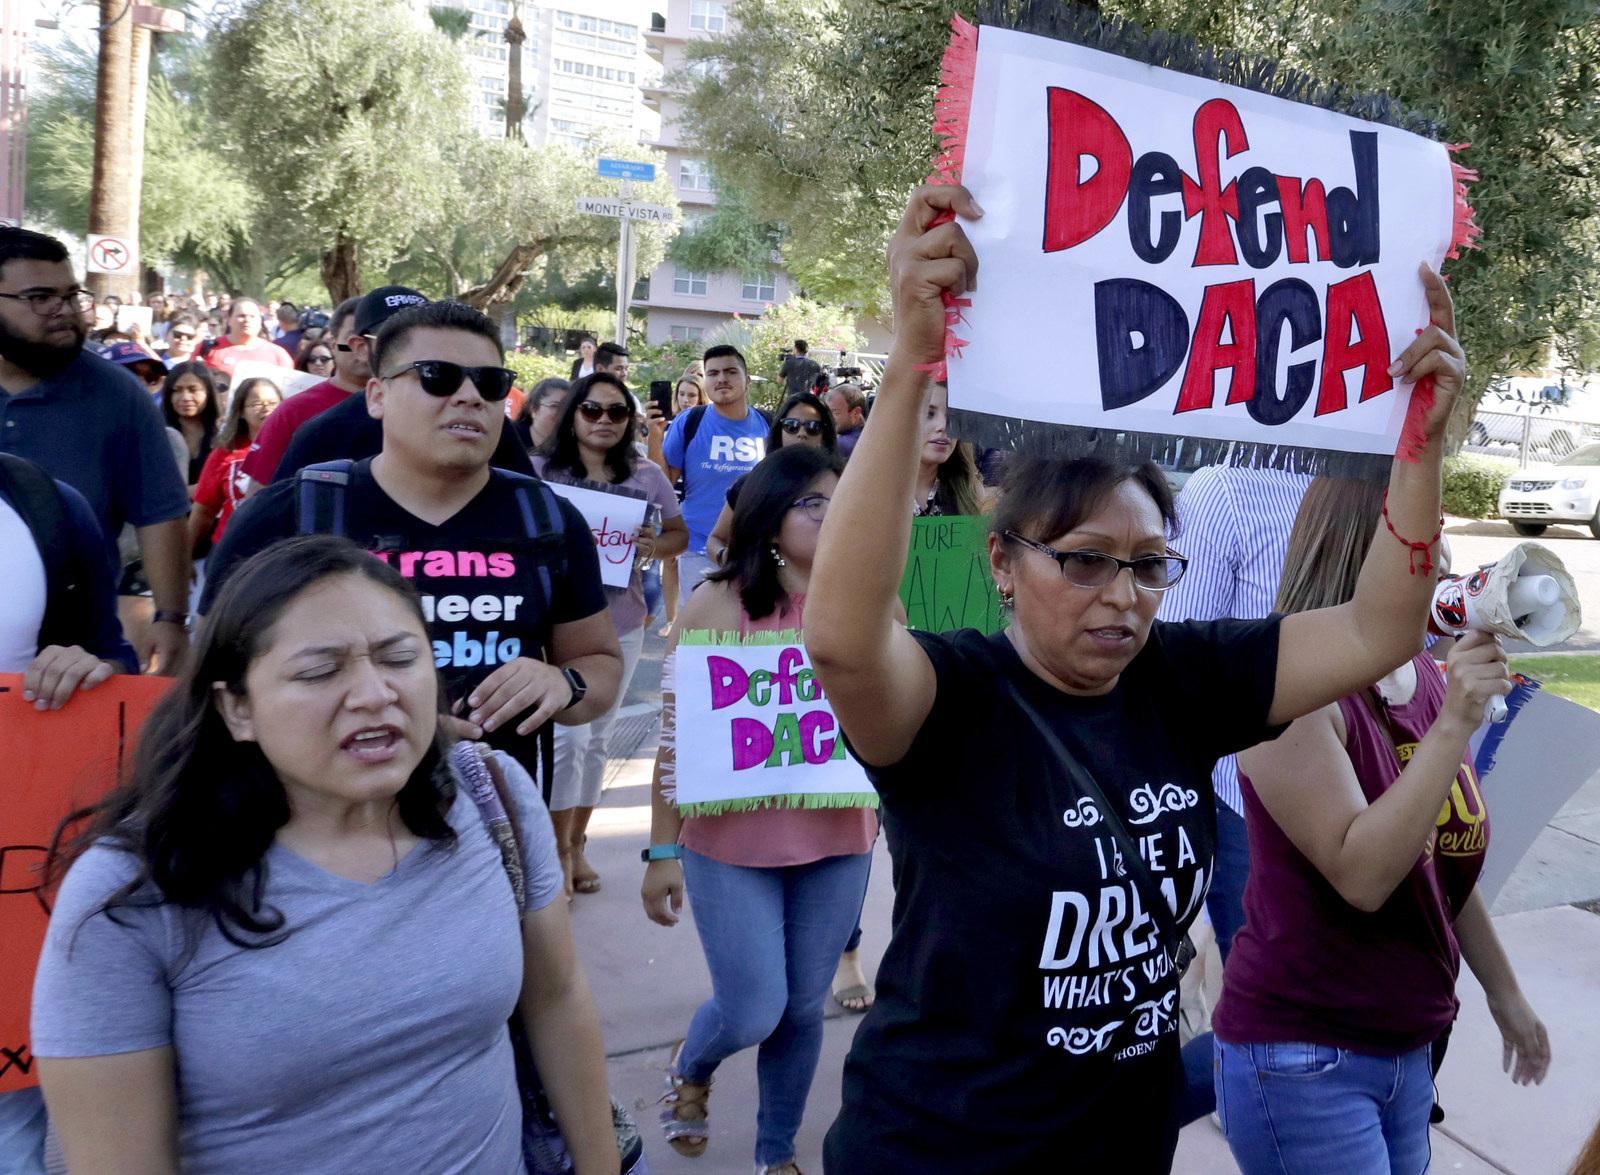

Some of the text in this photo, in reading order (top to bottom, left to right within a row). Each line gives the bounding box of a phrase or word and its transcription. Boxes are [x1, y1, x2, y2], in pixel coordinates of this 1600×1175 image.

[1043, 85, 1381, 269] Defend
[577, 202, 583, 210] E
[585, 202, 625, 217] MONTE
[628, 207, 660, 220] VISTA
[1094, 270, 1393, 425] DACA
[912, 522, 964, 552] TURE
[906, 552, 1003, 635] AWY
[431, 631, 521, 668] eblo
[1094, 837, 1107, 880] I
[1177, 825, 1196, 869] A
[1043, 966, 1136, 1009] WHAT'S
